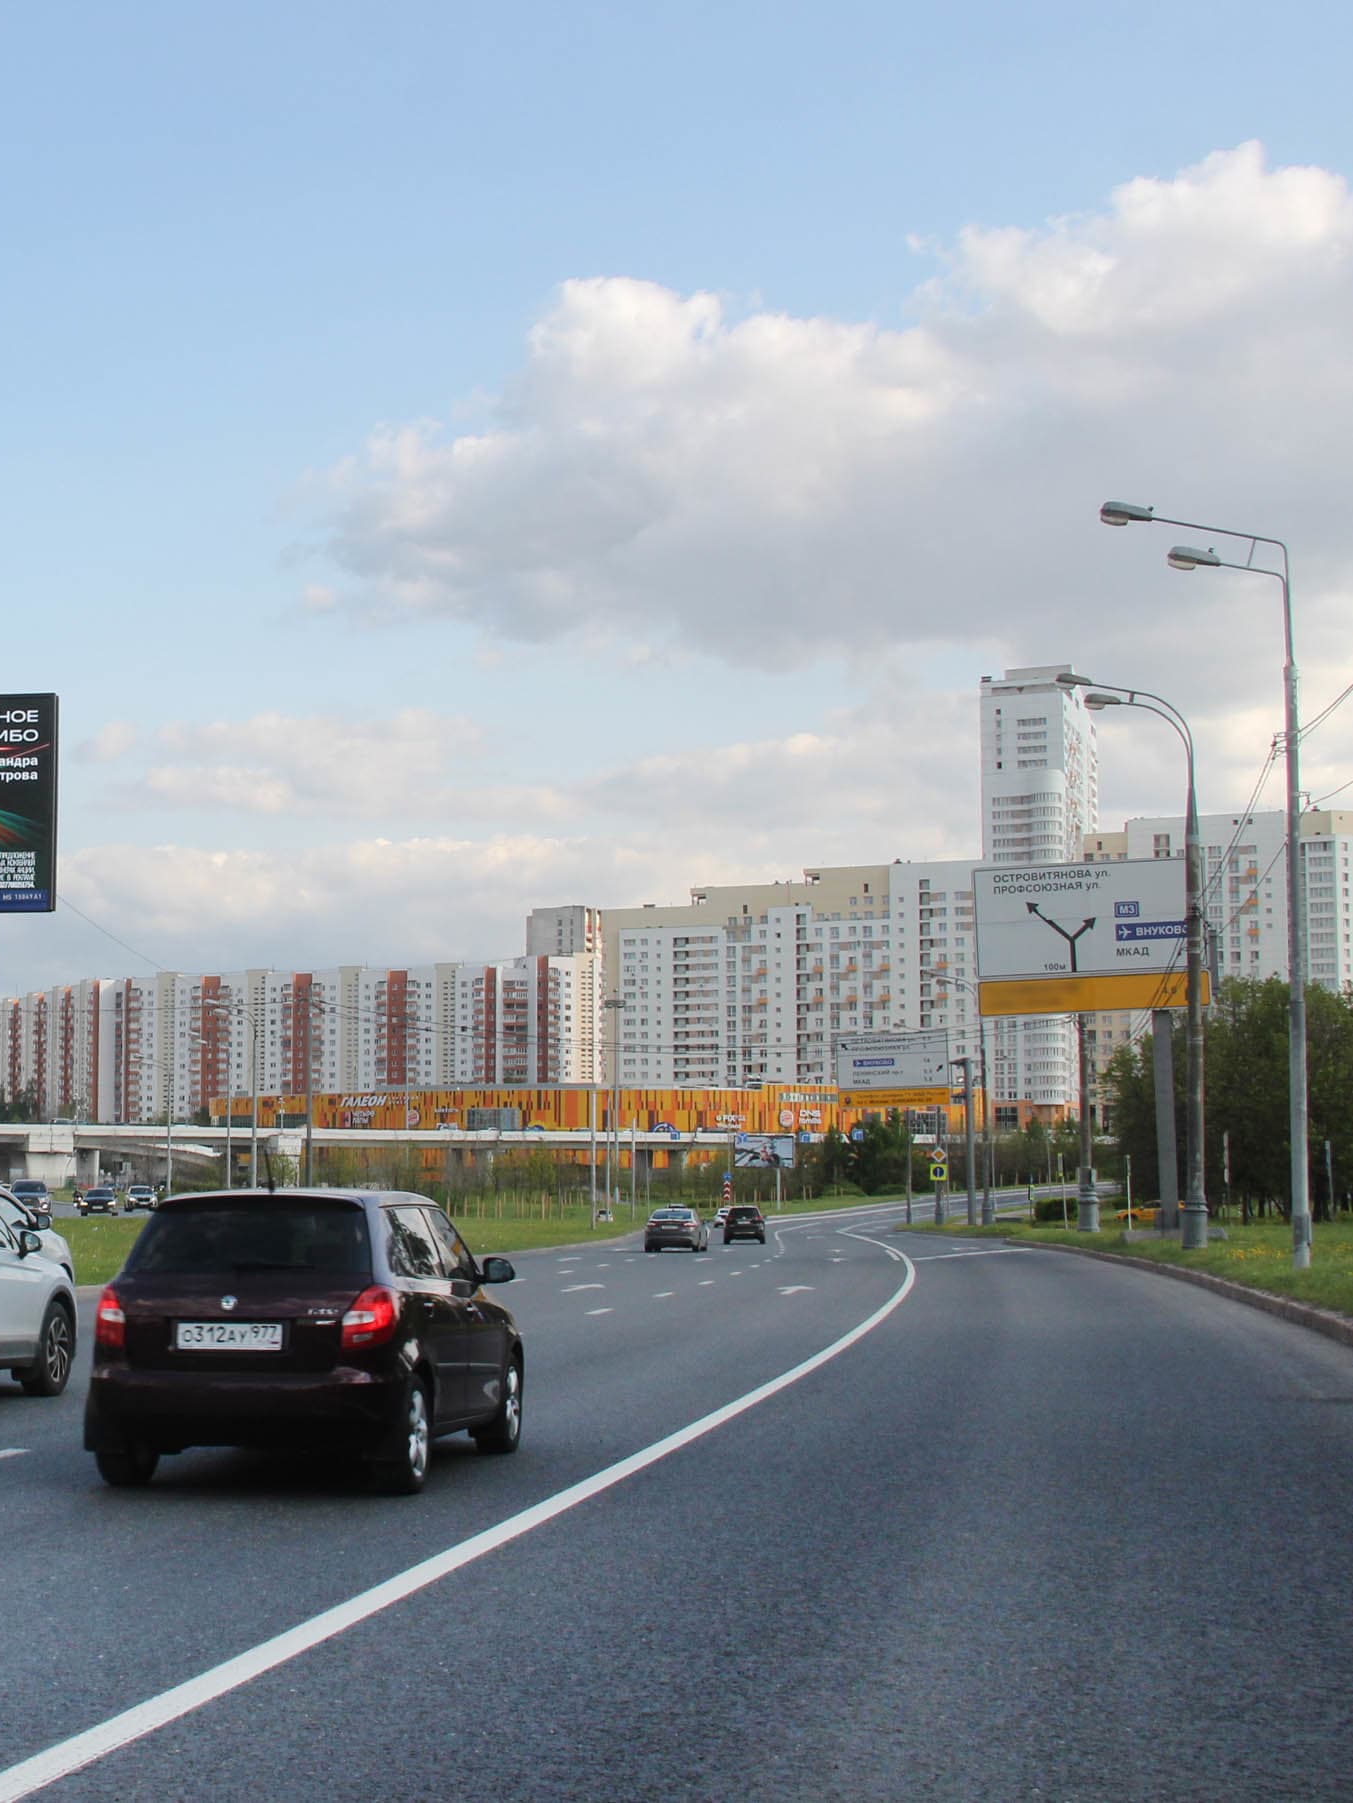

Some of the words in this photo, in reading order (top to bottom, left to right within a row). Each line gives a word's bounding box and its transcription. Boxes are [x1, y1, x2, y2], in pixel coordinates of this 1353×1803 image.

[993, 870, 1092, 884] ОСТРОВИТЯНОВА
[1094, 870, 1111, 880] ул.
[993, 882, 1082, 894] ПРОФСОЮЗНАЯ
[1086, 882, 1102, 892] ул.
[1119, 904, 1135, 914] М3
[1116, 946, 1149, 956] МКАД
[340, 1096, 387, 1107] ГАЛЕОН
[800, 1110, 820, 1118] DNS
[251, 1326, 277, 1338] 977
